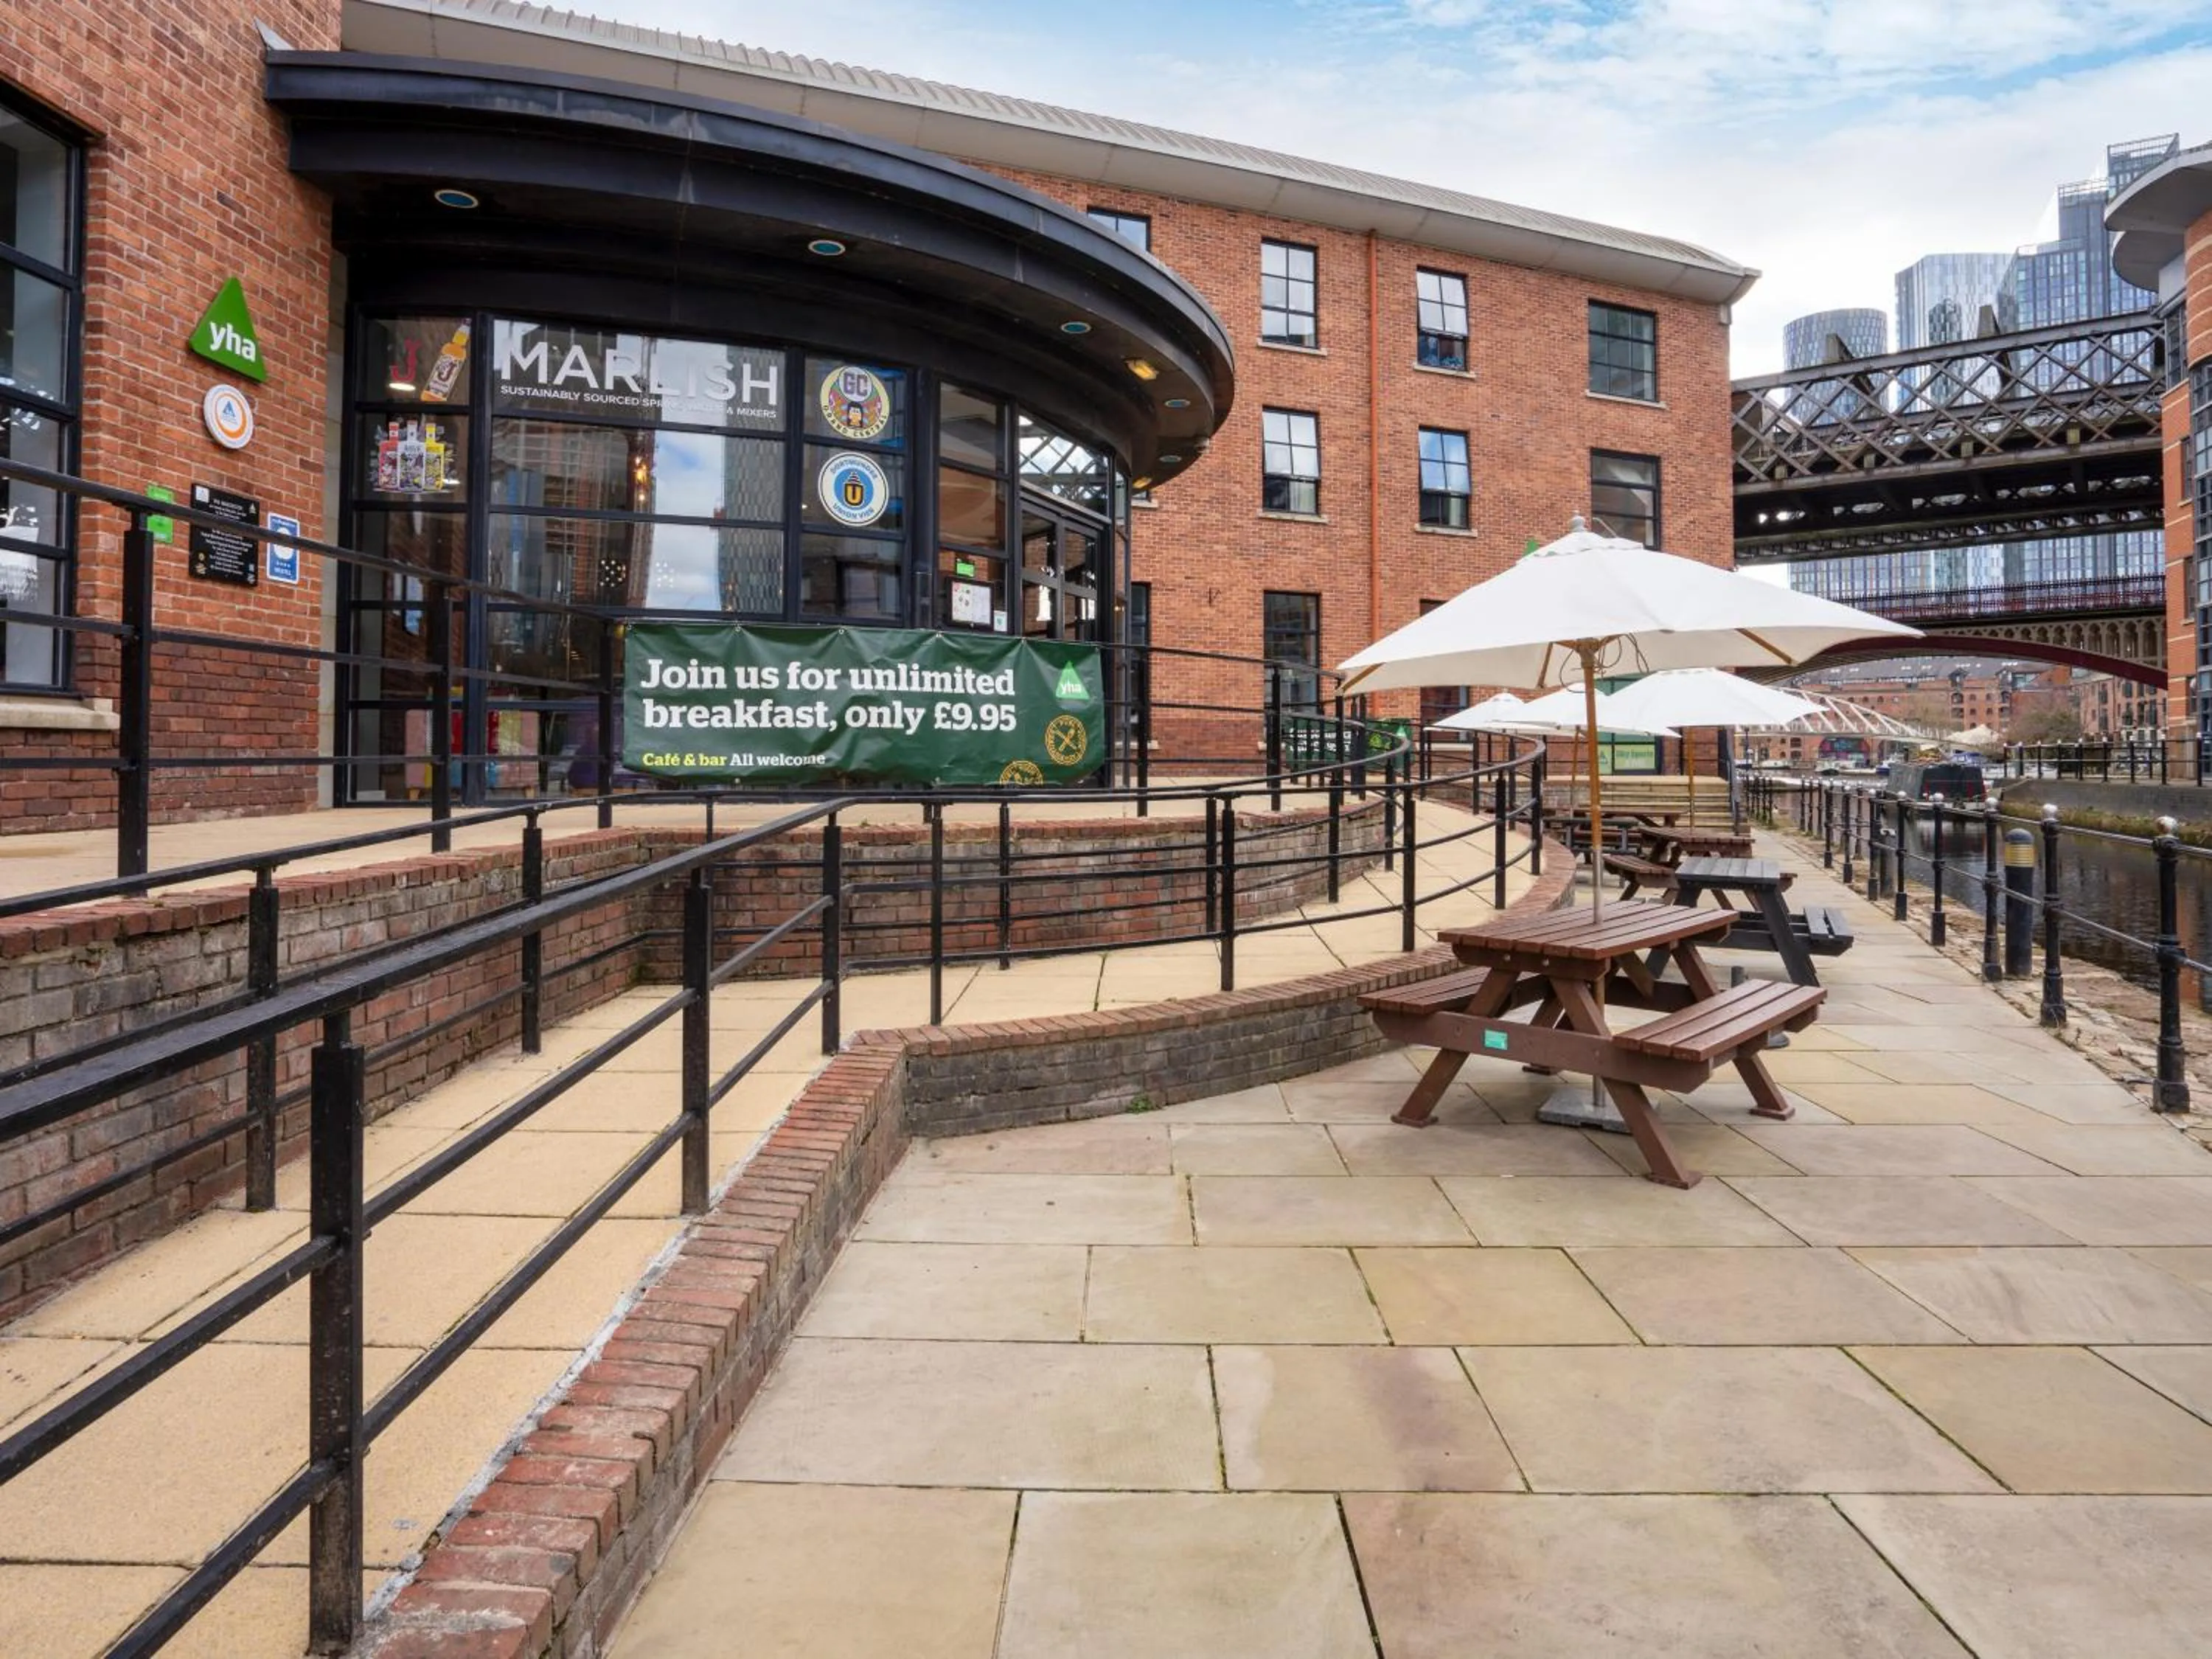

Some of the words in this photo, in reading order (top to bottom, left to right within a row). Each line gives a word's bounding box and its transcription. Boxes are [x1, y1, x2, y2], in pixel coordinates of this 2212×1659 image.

[209, 321, 256, 362] yha
[501, 339, 778, 405] MARLISH
[843, 372, 869, 397] GC
[501, 385, 580, 400] SUSTAINABLY
[583, 393, 639, 406] SOURCED
[737, 407, 776, 418] MIXERS
[641, 658, 727, 689] Join
[734, 666, 779, 689] us
[787, 661, 841, 691] for
[849, 664, 1015, 696] unlimited
[1060, 678, 1082, 695] yha
[642, 699, 838, 731] breakfast,
[845, 700, 926, 735] only
[934, 701, 1017, 731] £9.95
[642, 753, 681, 766] Café
[683, 754, 696, 766] &
[699, 754, 728, 766] bar
[729, 753, 754, 766] All
[756, 753, 825, 766] welcome
